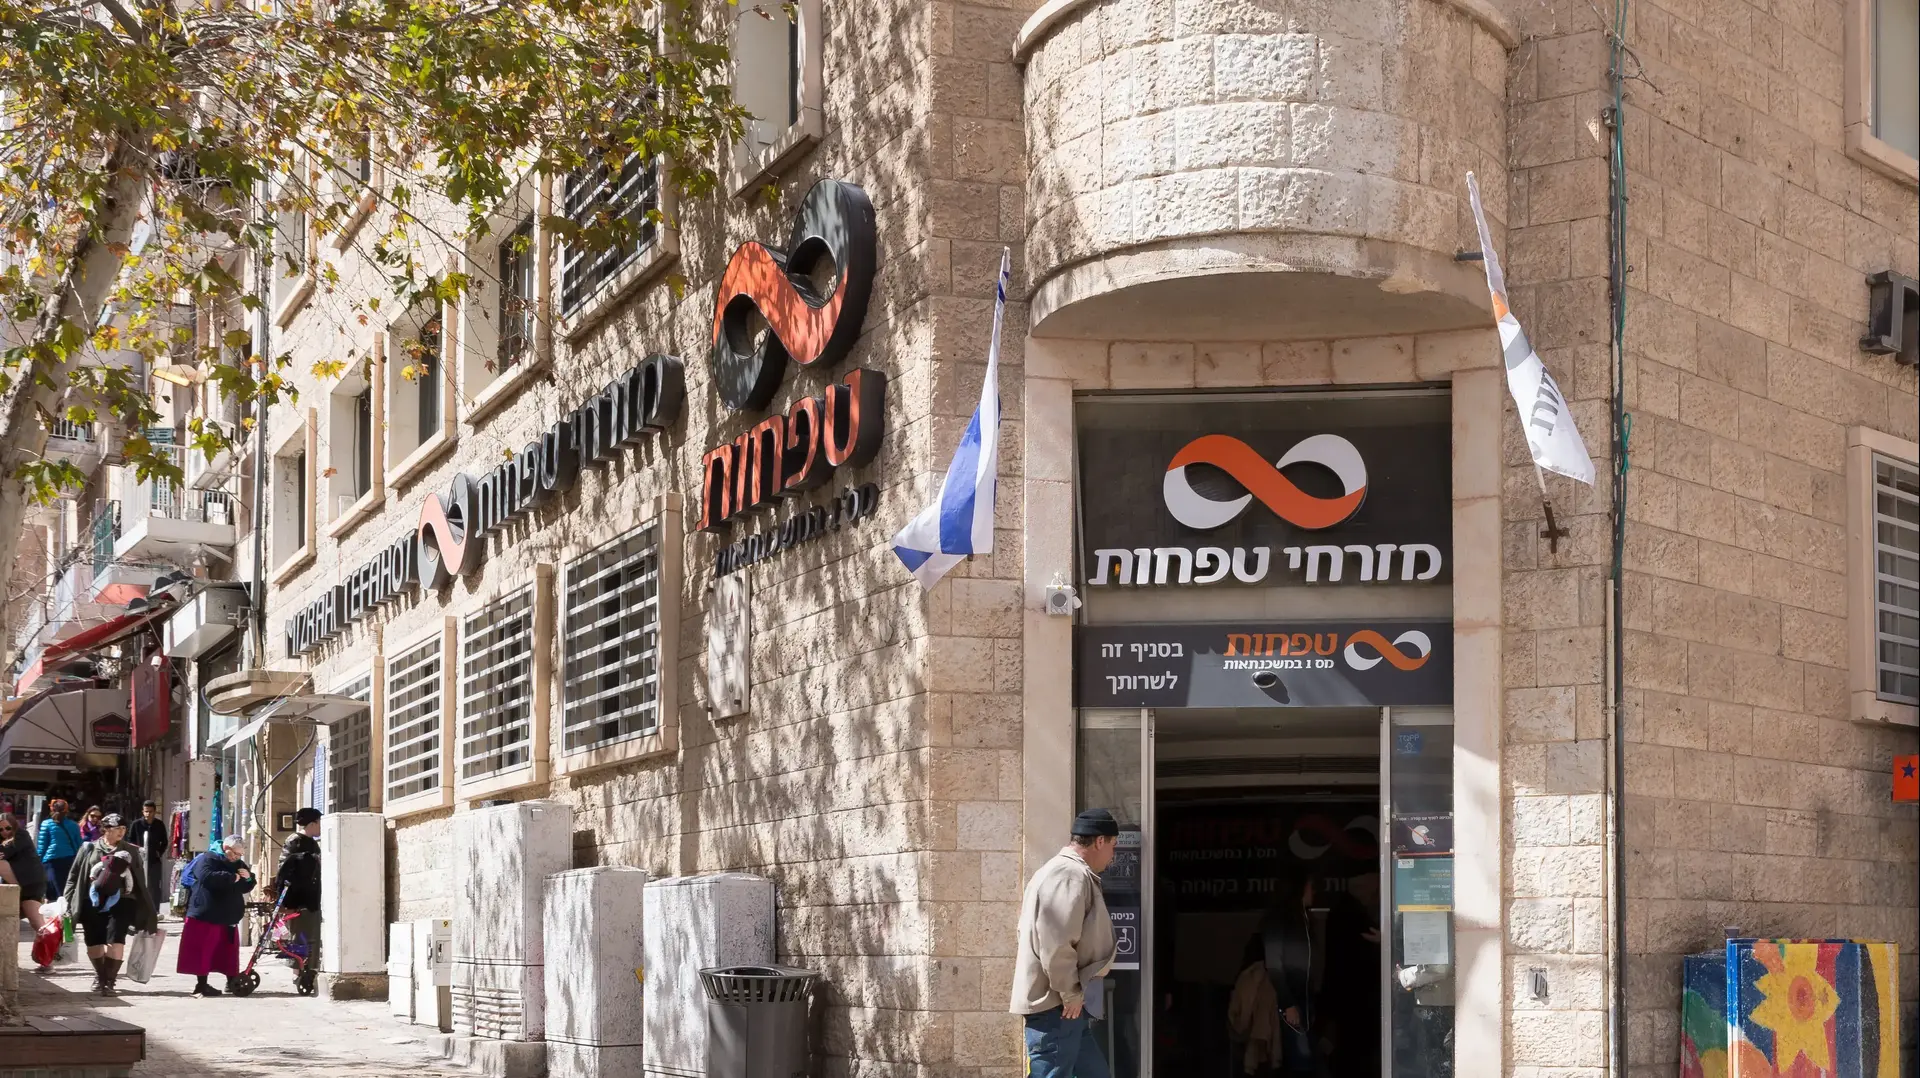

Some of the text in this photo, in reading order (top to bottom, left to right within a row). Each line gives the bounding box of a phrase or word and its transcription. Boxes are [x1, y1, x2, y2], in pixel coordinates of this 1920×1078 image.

[475, 353, 684, 539] מזרחי טפחות
[696, 367, 885, 533] טפחות
[1088, 543, 1443, 586] מזרחי טפחות
[284, 528, 418, 660] MIZRAHI TEFAHOT
[1101, 643, 1184, 663] בסניף זה
[1223, 633, 1339, 657] טפחות
[1222, 659, 1303, 670] במשכנתאות
[1105, 670, 1178, 695] לשרותך
[1110, 912, 1135, 921] כניסה
